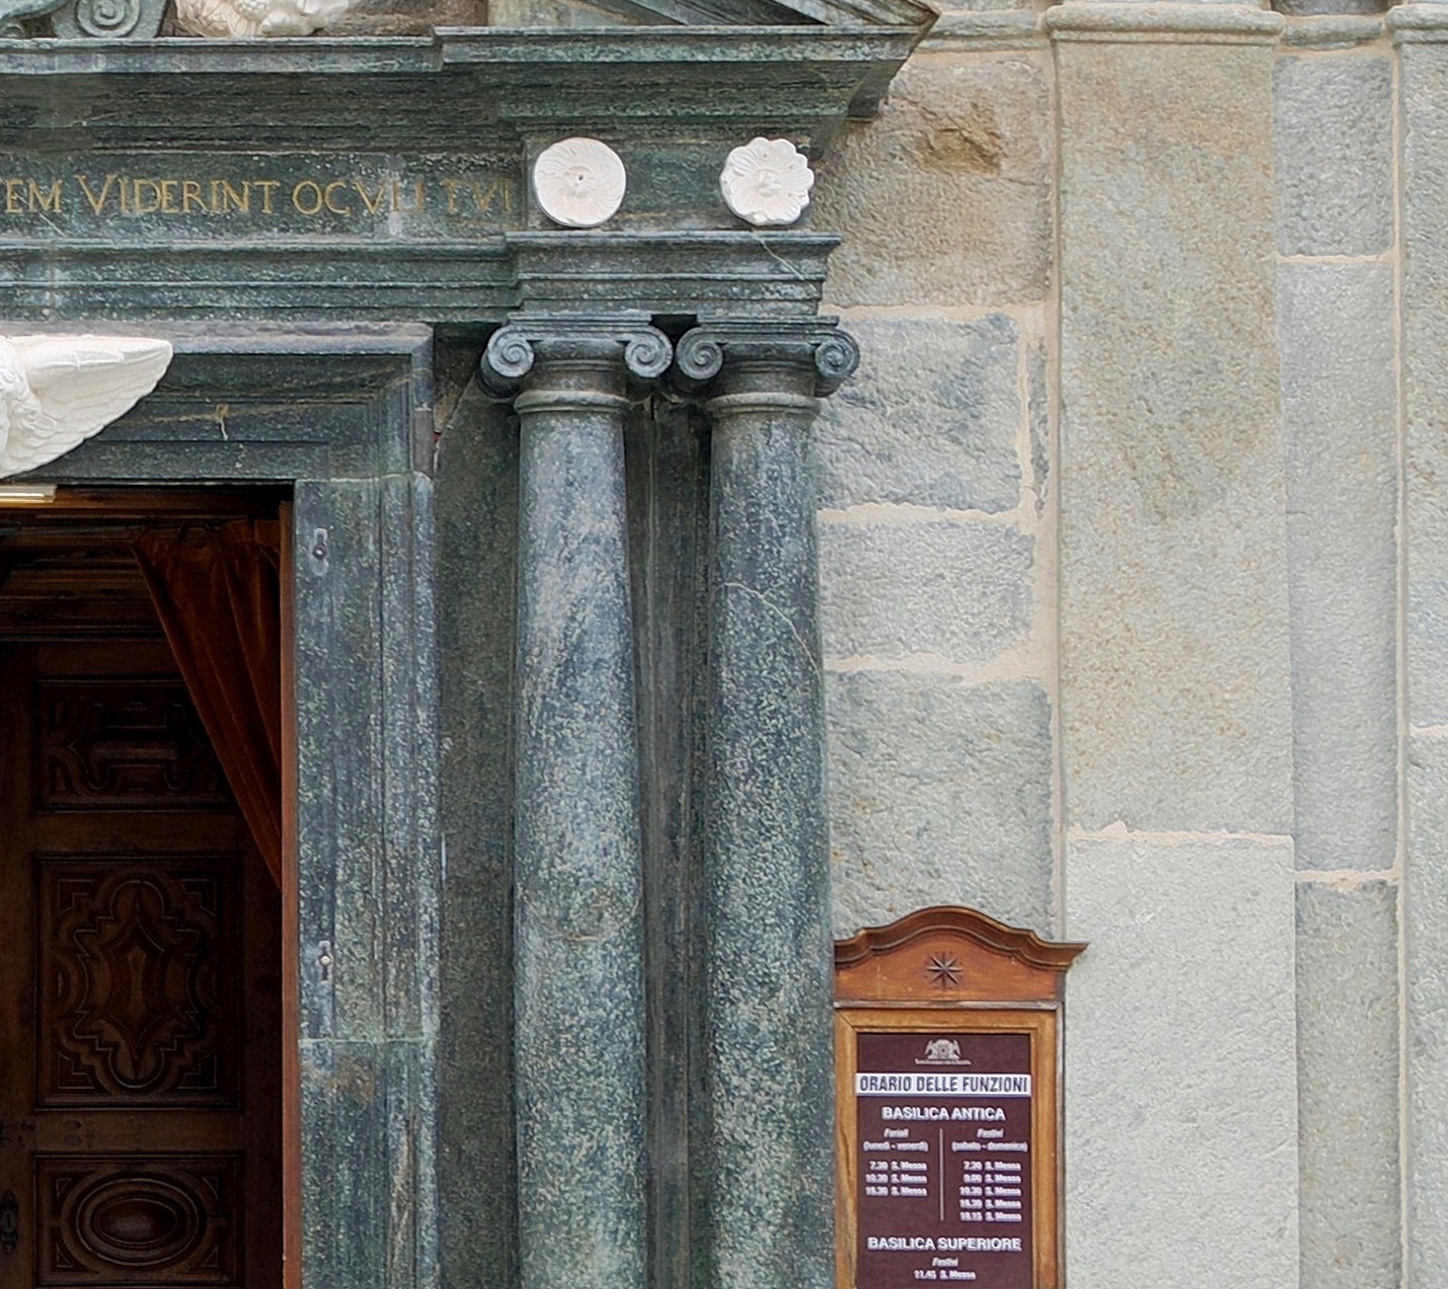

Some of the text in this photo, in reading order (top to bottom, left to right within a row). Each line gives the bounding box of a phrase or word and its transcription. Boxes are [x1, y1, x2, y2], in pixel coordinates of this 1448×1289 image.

[74, 174, 280, 216] VIDERINT
[292, 178, 425, 216] OCVLI
[859, 1075, 1028, 1093] ORARIO DELLE FUNZIONI
[881, 1106, 1007, 1121] BASILICA ANTICA
[867, 1237, 1022, 1251] BASILICA SUPERIORE
